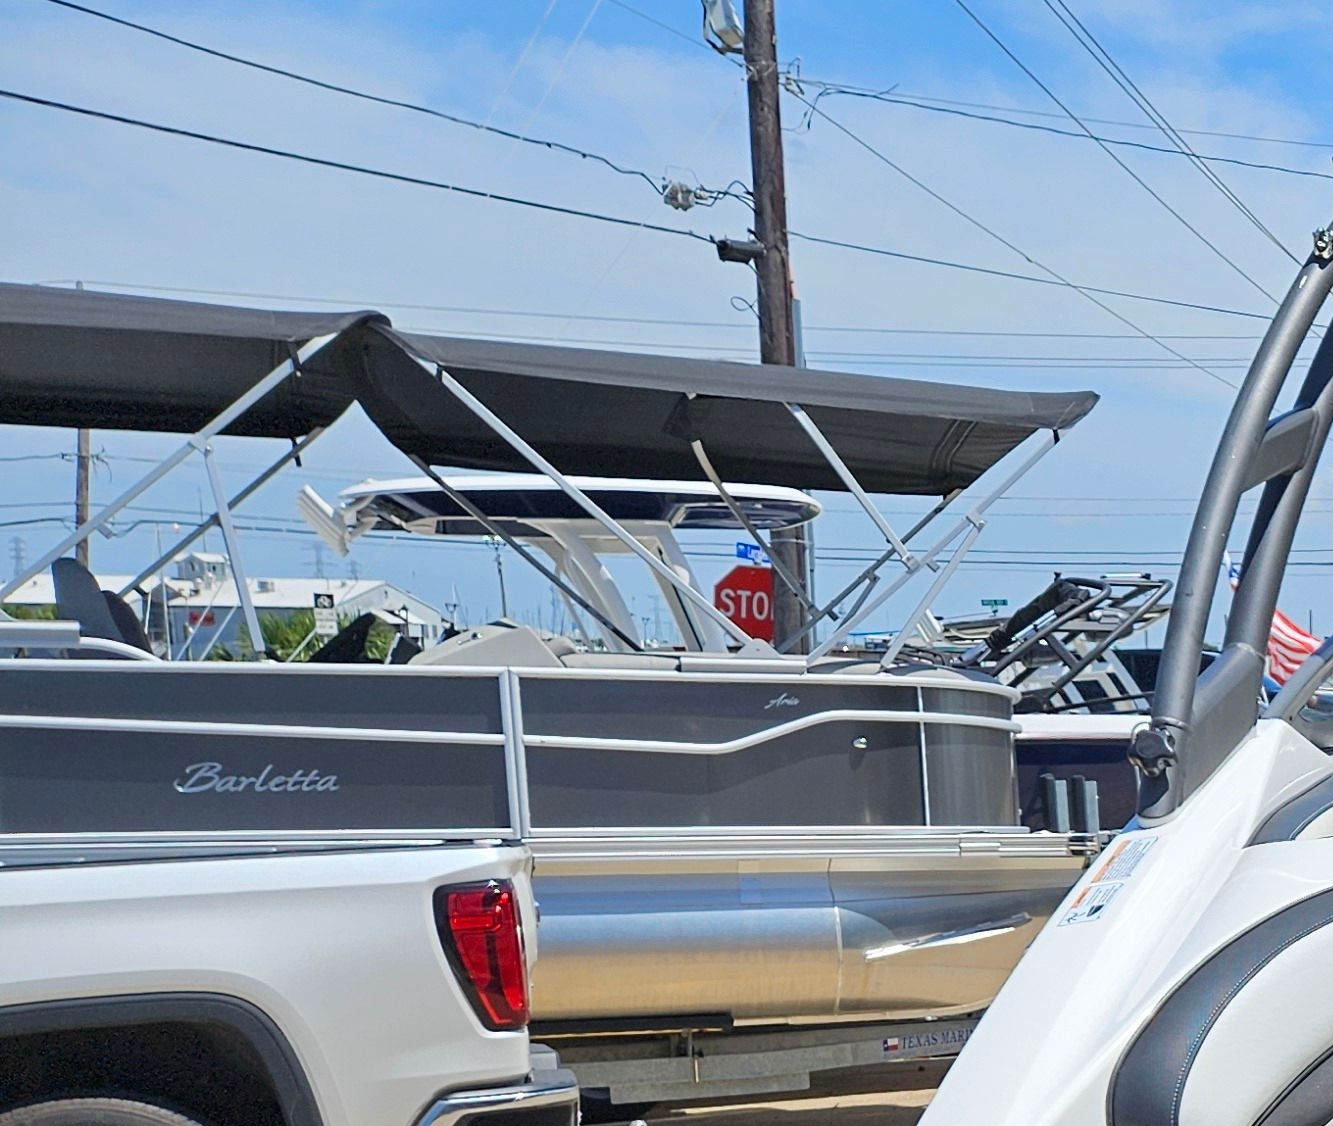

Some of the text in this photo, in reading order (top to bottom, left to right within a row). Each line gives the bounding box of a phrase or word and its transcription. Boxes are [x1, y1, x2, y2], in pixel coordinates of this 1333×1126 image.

[720, 588, 775, 621] STO
[173, 761, 340, 793] Barletta
[902, 1031, 938, 1050] TEXAS
